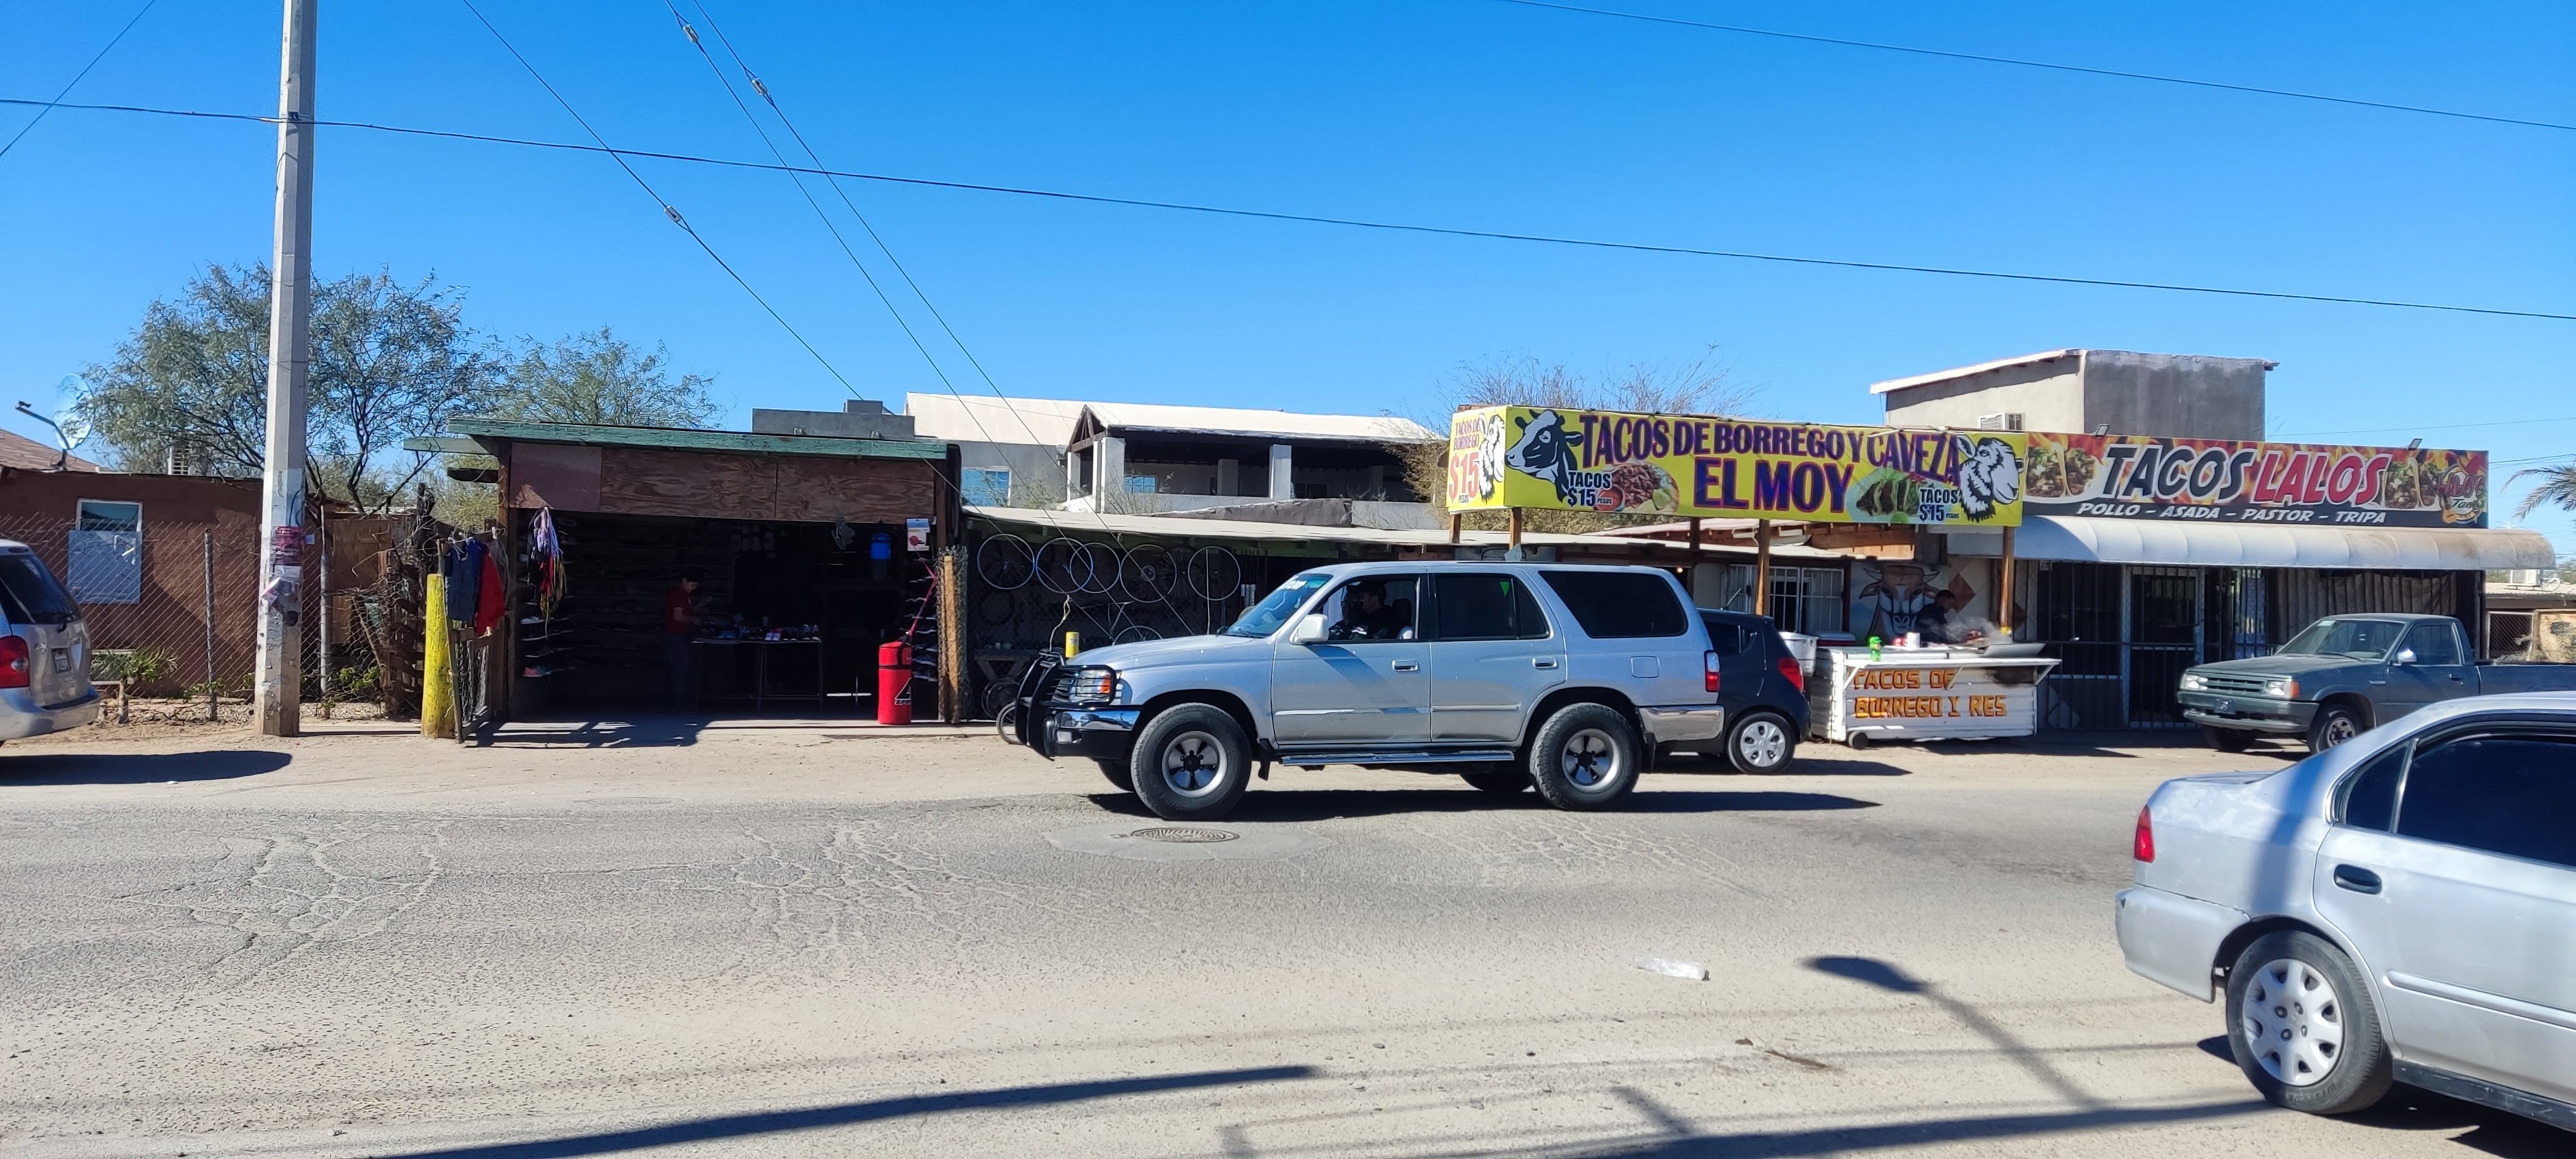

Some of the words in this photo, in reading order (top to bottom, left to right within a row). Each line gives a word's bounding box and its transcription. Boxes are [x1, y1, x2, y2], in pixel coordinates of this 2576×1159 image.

[1455, 419, 1472, 436] TACOS
[1454, 434, 1479, 451] BORREGO
[1579, 414, 1670, 468] TACOS
[1673, 420, 1710, 456] DE
[1714, 422, 1845, 460] BORREGO
[1847, 430, 1864, 463] Y
[1867, 430, 1961, 487] CAVEZA
[1449, 451, 1479, 503] $15
[1568, 471, 1611, 489] TACOS
[1694, 456, 1750, 509] EL
[1754, 459, 1855, 513] MOY
[2098, 444, 2259, 504] TACOS
[2250, 450, 2392, 507] LALOS
[1920, 488, 1958, 504] TACOS
[2436, 474, 2486, 498] LALO'S
[1458, 495, 1469, 503] PESOS
[1567, 487, 1596, 507] $15
[2452, 498, 2485, 509] Tacos
[1919, 503, 1945, 522] $15
[2077, 502, 2141, 516] POLLO
[2159, 505, 2221, 518] ASADA
[2240, 508, 2315, 522] PASTOR
[2335, 511, 2387, 523] TRIPA
[1854, 668, 1922, 690] TACOS
[1929, 669, 1958, 690] DE
[1854, 695, 1944, 718] BORREGO
[1948, 695, 1961, 717] Y
[1969, 695, 2007, 717] RES
